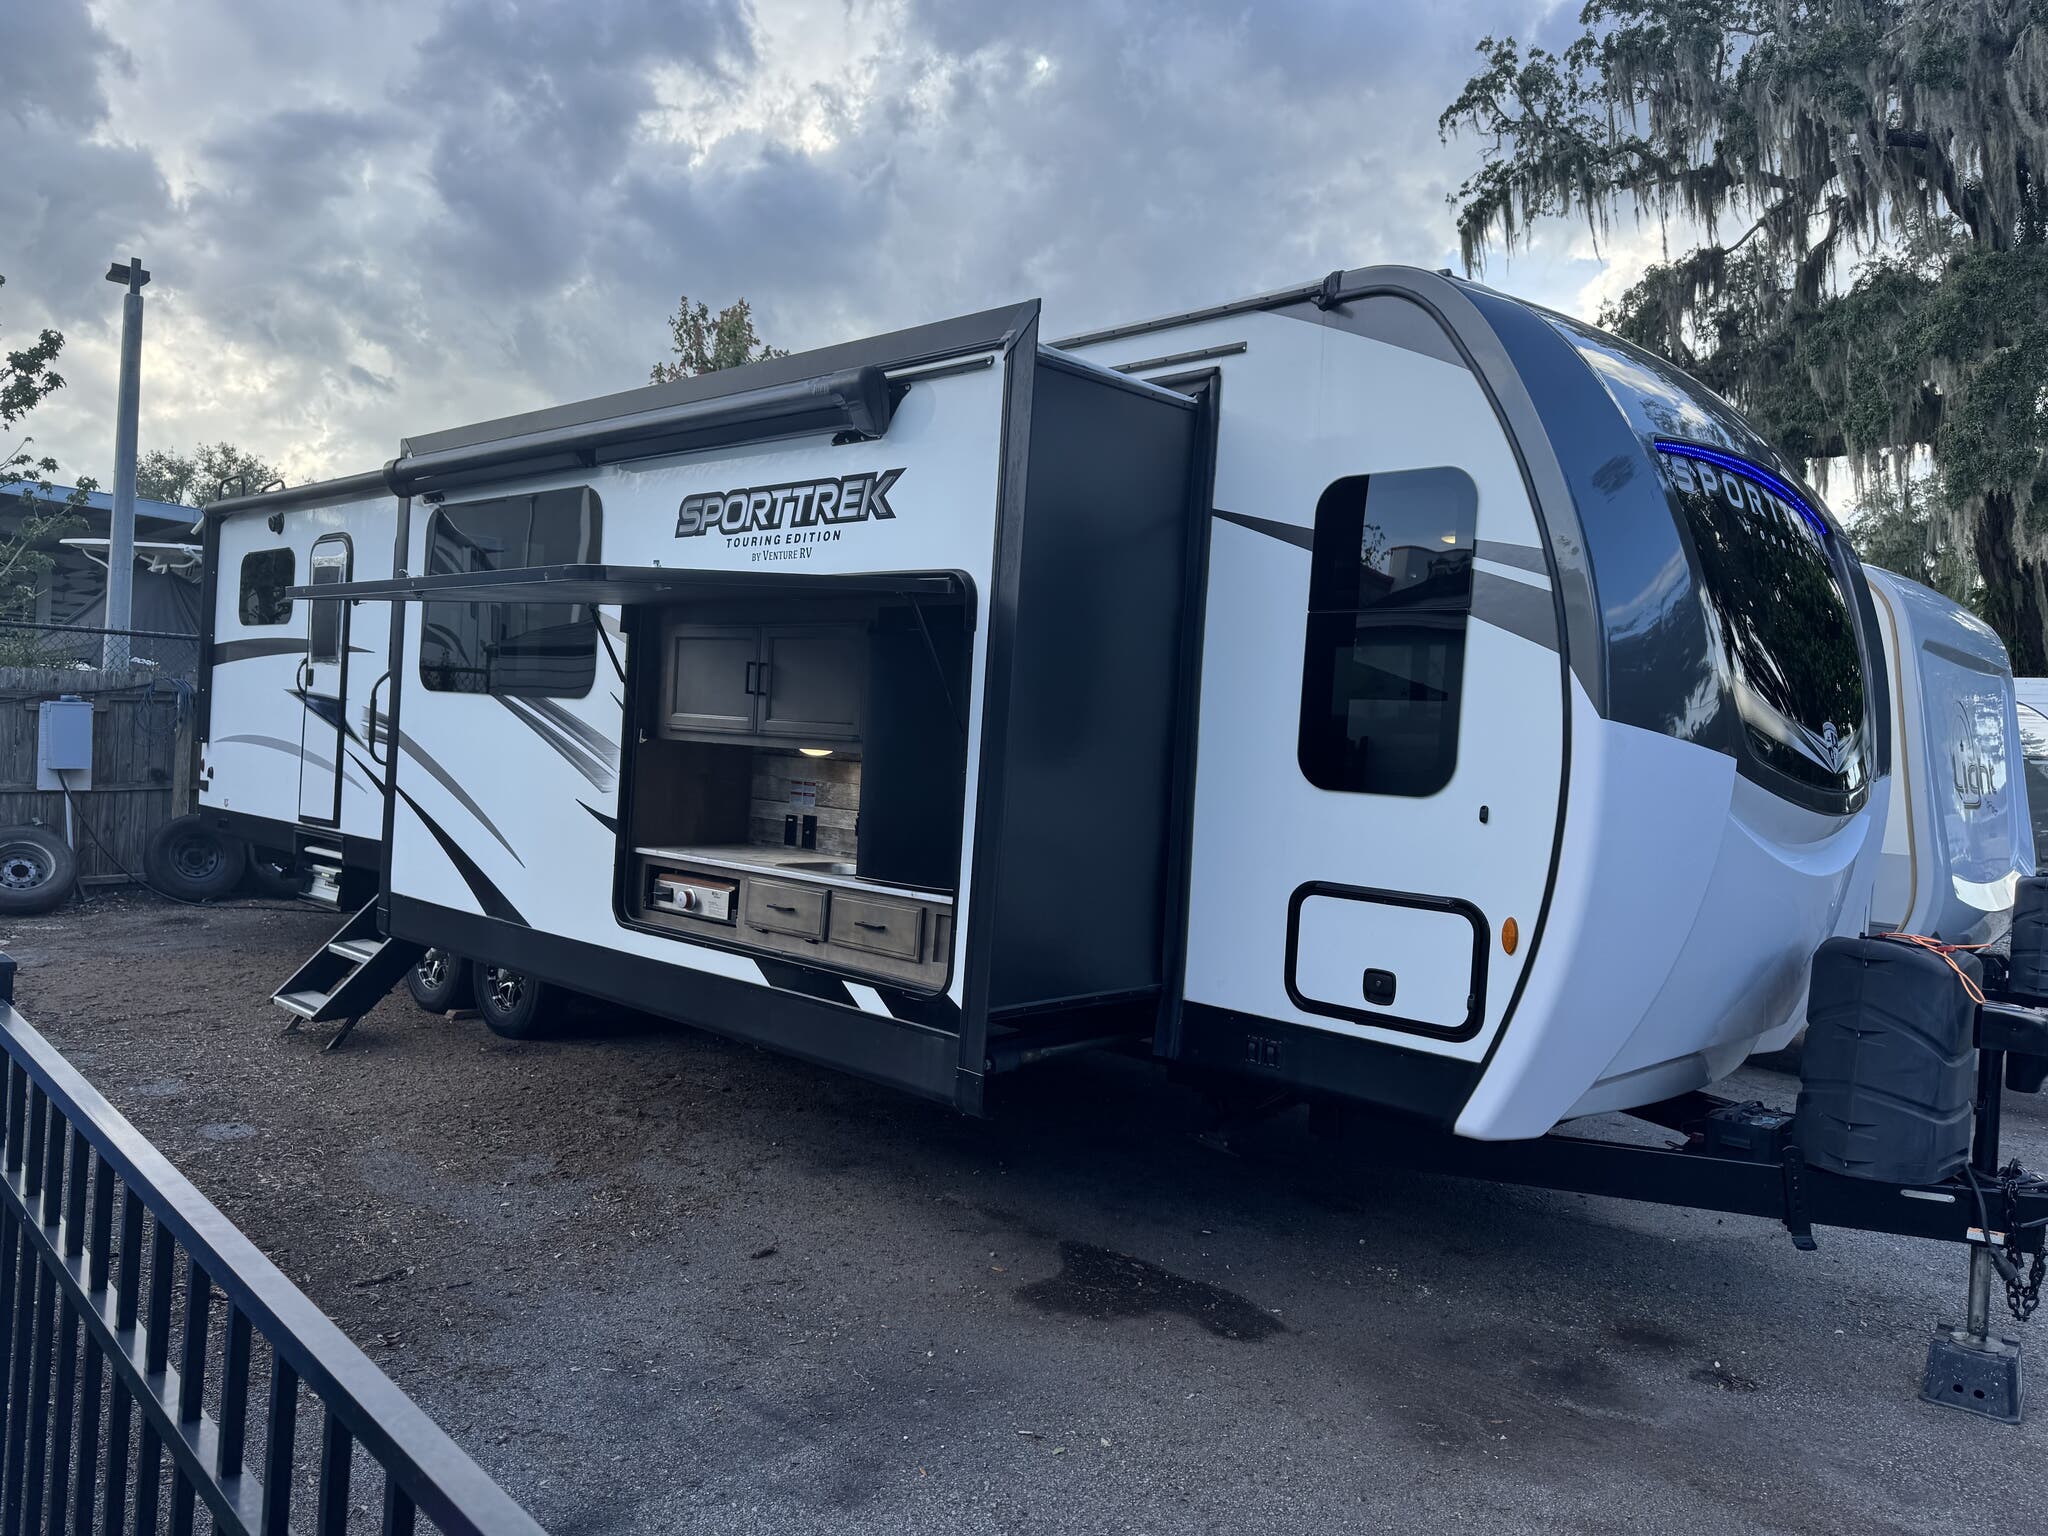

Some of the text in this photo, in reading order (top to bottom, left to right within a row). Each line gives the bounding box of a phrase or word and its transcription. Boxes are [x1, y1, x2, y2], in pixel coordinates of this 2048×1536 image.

[675, 468, 907, 538] SPORTTREK
[726, 530, 842, 549] TOURING EDITION
[799, 546, 813, 560] RV
